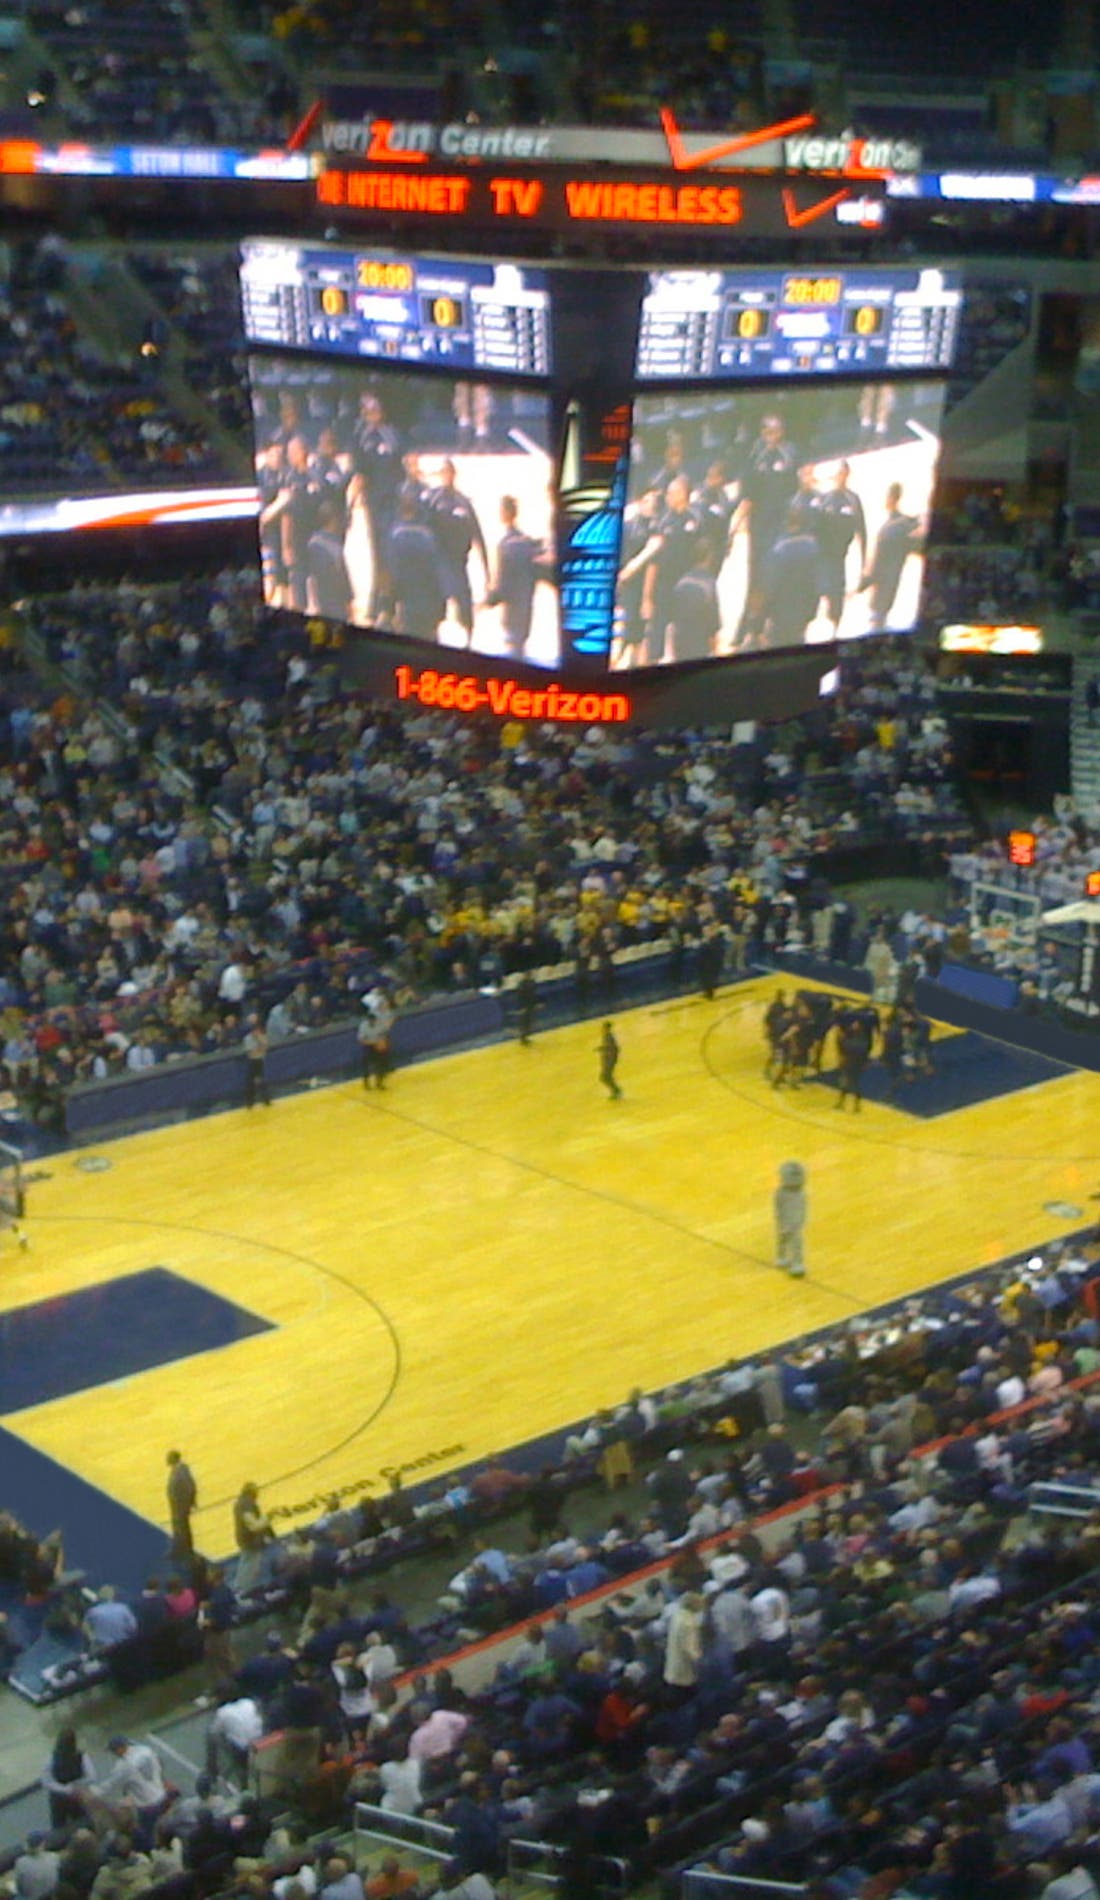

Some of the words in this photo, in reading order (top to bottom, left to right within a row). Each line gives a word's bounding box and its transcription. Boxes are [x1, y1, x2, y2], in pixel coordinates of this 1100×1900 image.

[322, 114, 431, 163] verizon
[440, 125, 550, 158] Center
[784, 130, 892, 179] verizon
[347, 171, 470, 214] INTERNET
[490, 179, 543, 217] TV
[566, 182, 741, 225] WIRELESS
[357, 261, 414, 290] 20:00
[783, 277, 841, 304] 20:00
[321, 286, 346, 316] 0
[432, 297, 459, 327] 0
[737, 308, 762, 339] 0
[854, 306, 877, 335] 0
[394, 665, 631, 722] 1-866-Verizon
